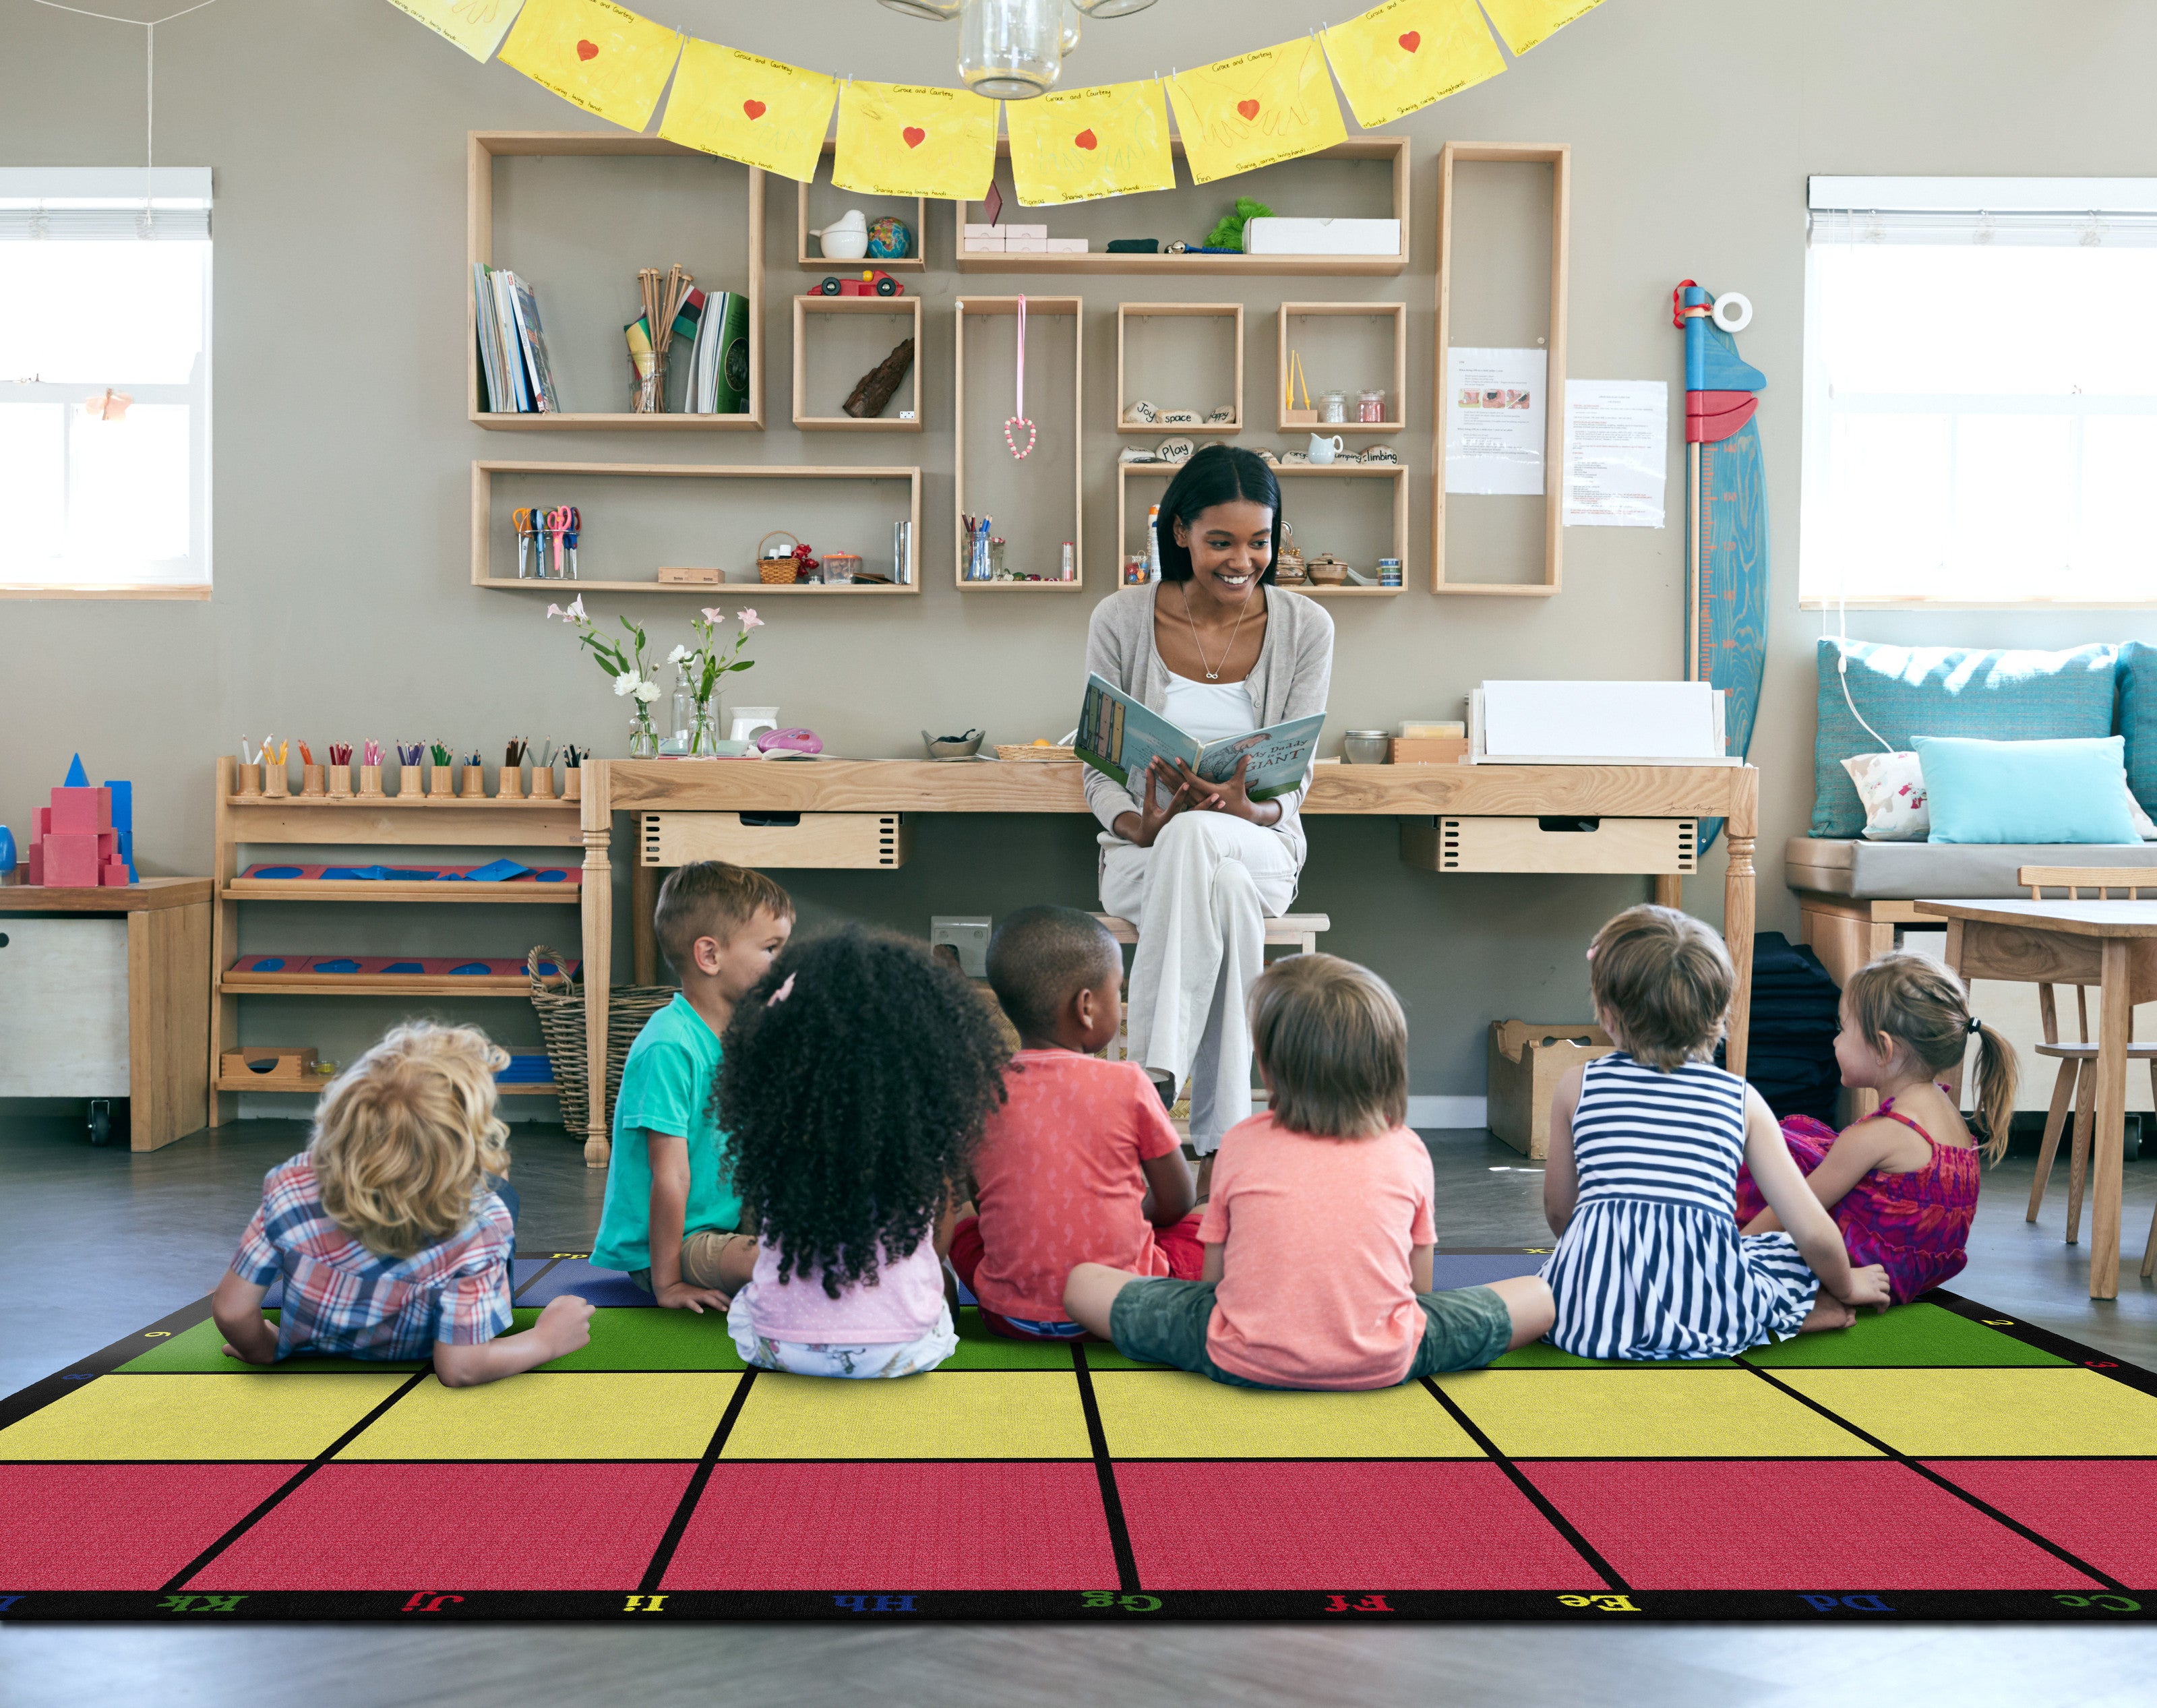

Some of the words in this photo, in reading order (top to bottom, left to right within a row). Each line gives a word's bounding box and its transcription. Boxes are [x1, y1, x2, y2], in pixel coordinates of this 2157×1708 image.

[1366, 9, 1384, 20] Grace
[734, 51, 752, 61] Grace
[1212, 63, 1230, 72] Grace
[893, 85, 911, 93] Grace
[1045, 94, 1064, 102] Grace
[1196, 173, 1211, 184] Finn
[1137, 402, 1155, 423] Joy
[1165, 415, 1191, 424] space
[1724, 444, 1737, 454] 140
[1271, 739, 1308, 753] Daddy
[1246, 748, 1305, 772] GIANT
[2084, 1360, 2119, 1368] 3
[157, 1595, 248, 1612] Kk
[401, 1591, 464, 1612] Jj
[624, 1595, 669, 1612] Ii
[832, 1595, 917, 1612] Hh
[1081, 1590, 1162, 1612] Gg
[1324, 1594, 1395, 1612] Ff
[1556, 1594, 1642, 1612] Ee
[1798, 1594, 1896, 1612] Dd
[2053, 1594, 2141, 1612] Cc
